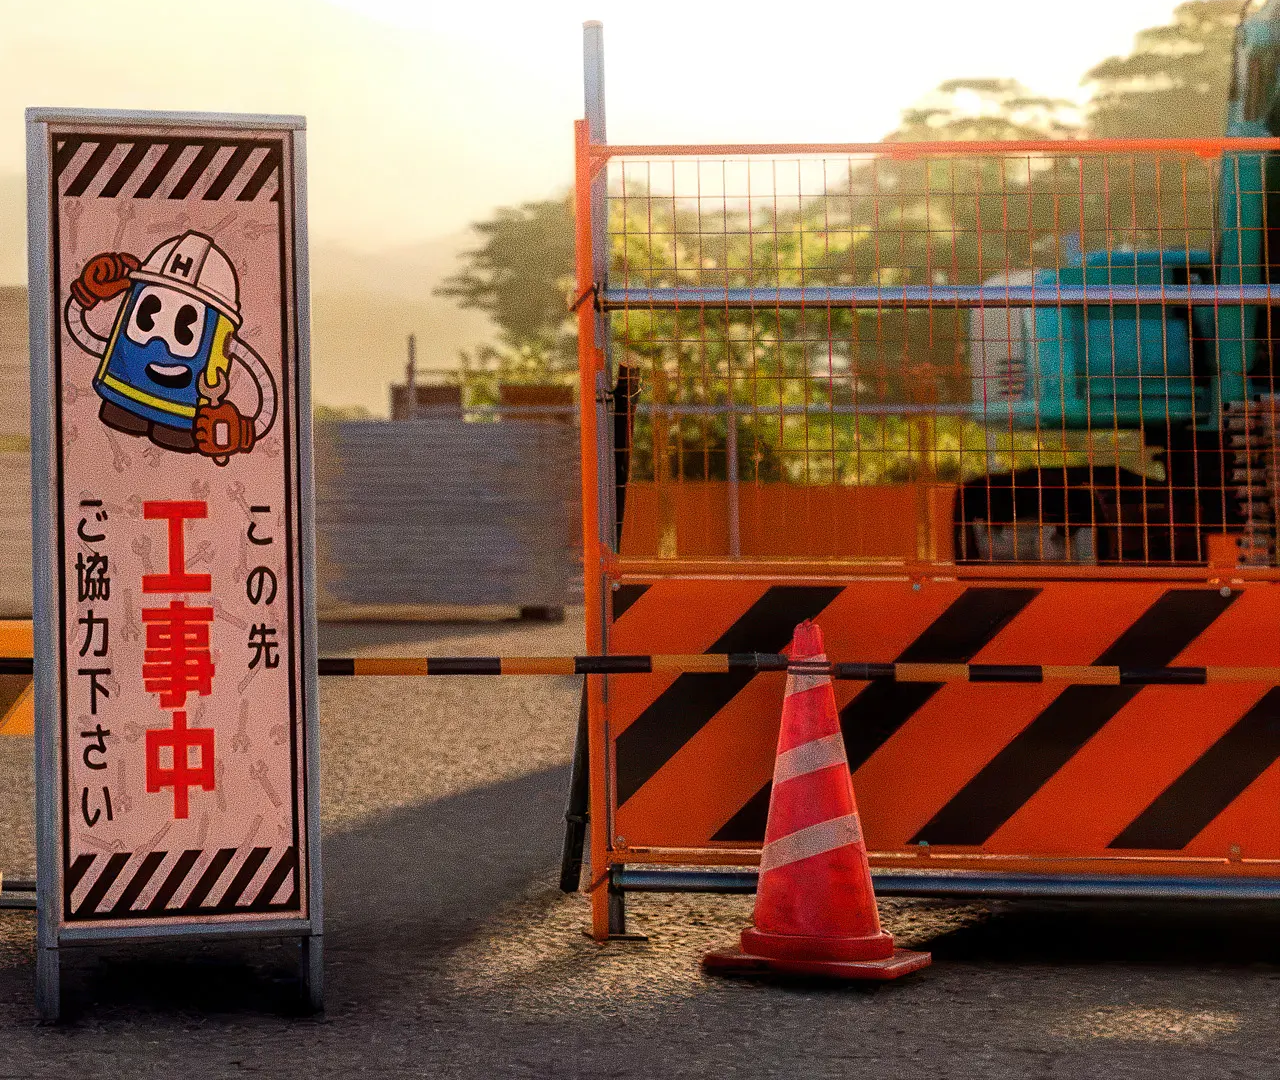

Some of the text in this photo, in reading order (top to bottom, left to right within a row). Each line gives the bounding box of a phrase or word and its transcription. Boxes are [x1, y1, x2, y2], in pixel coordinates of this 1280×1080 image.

[74, 499, 114, 828] ご協力下さい
[141, 499, 215, 820] 工事中
[246, 505, 280, 670] この先
